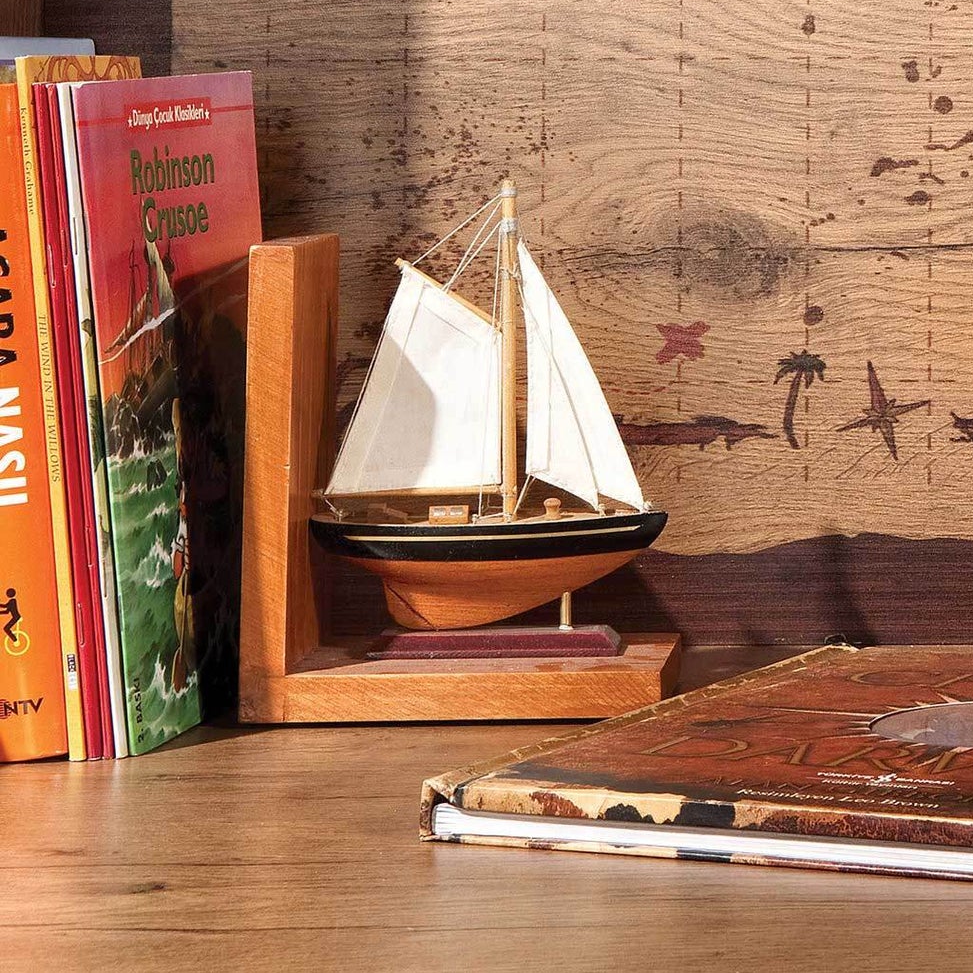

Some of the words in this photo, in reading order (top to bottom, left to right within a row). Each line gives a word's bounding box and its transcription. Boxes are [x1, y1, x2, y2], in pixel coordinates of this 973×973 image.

[132, 108, 153, 128] Dünya
[153, 106, 174, 128] Çocuk
[174, 104, 206, 124] Klasikleri
[19, 106, 32, 159] Kenneth
[129, 144, 216, 196] Robinson
[141, 197, 209, 243] Crusoe
[38, 315, 48, 339] THE
[41, 341, 51, 375] WIND
[44, 380, 53, 393] IN
[45, 396, 55, 421] THE
[48, 424, 60, 483] WILLOWS
[4, 698, 43, 715] NTV
[736, 788, 835, 802] Resimleyen
[838, 795, 876, 804] Leo
[879, 798, 941, 810] Brown
